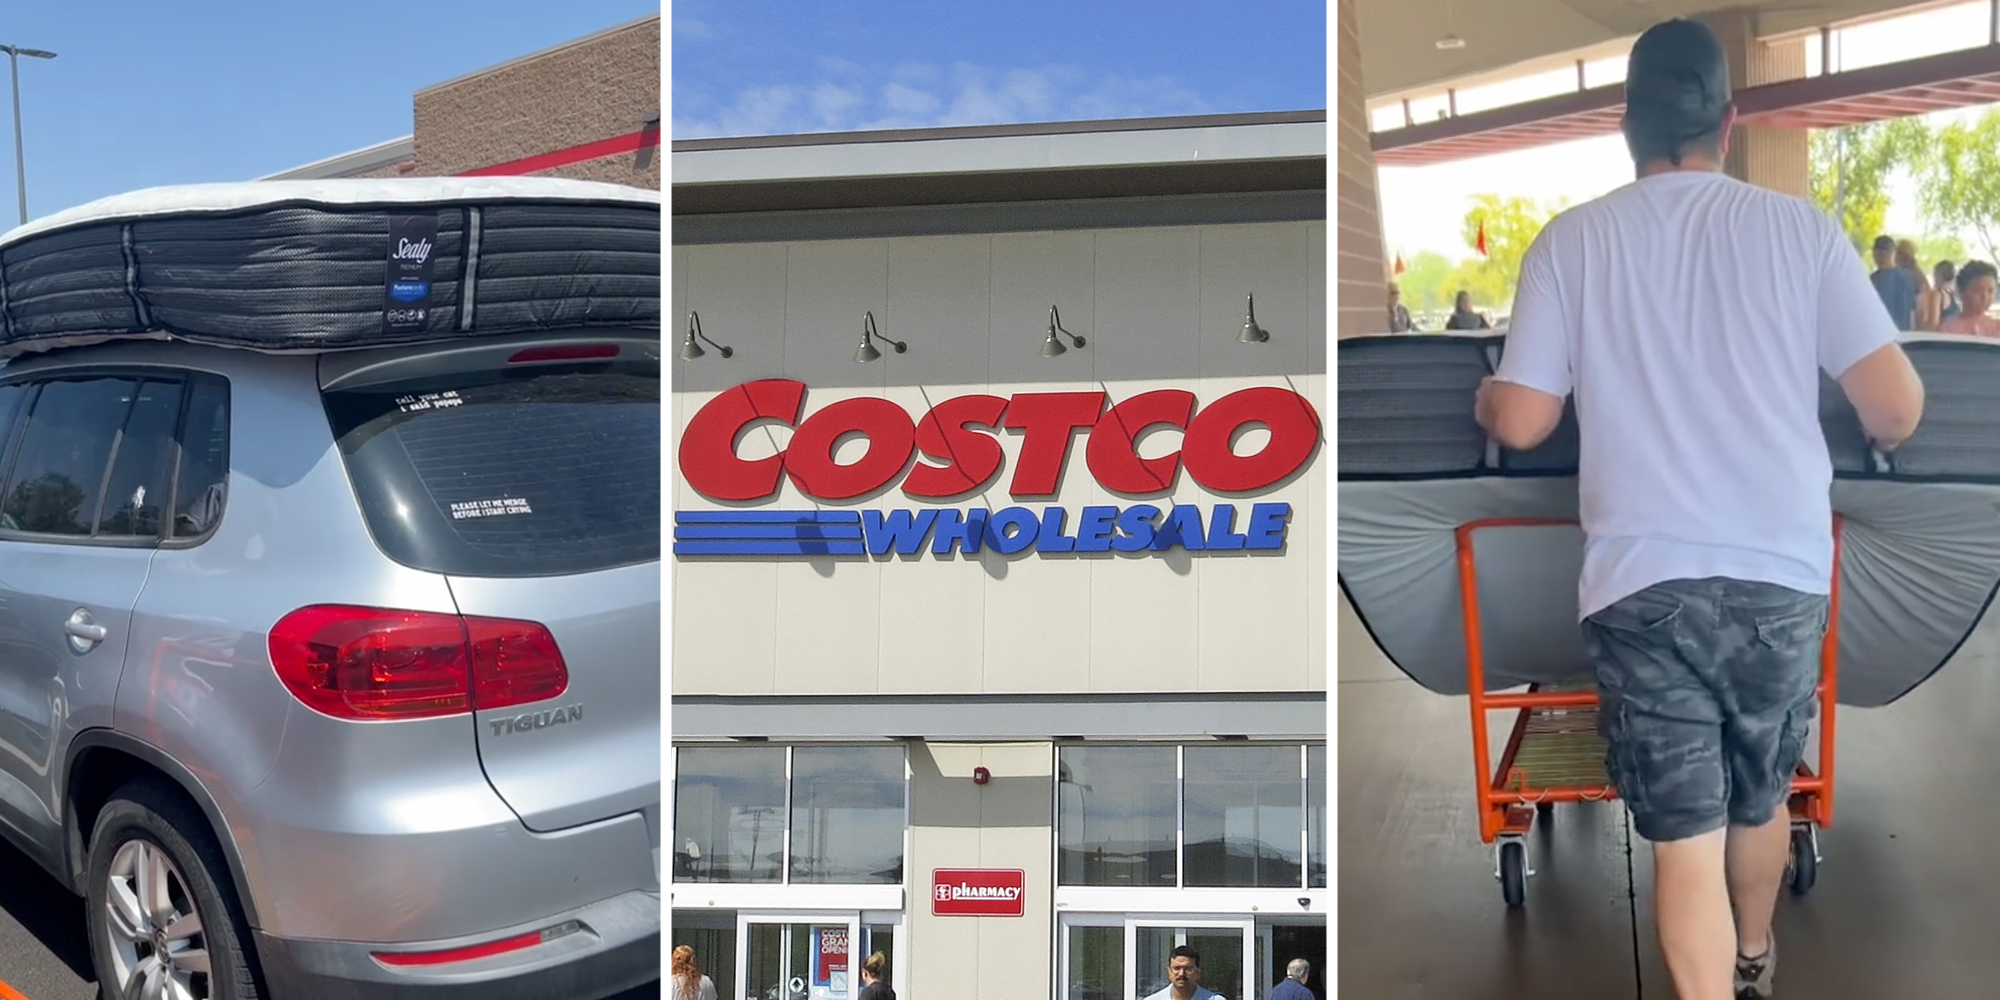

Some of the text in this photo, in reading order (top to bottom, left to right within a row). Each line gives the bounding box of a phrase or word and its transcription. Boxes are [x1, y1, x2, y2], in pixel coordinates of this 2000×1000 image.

[392, 237, 432, 264] Sealy
[395, 390, 459, 405] tell your cat
[410, 401, 431, 411] said
[679, 379, 1320, 500] COSTCO
[450, 498, 527, 511] PLEASE LET ME MERGE
[452, 510, 482, 520] BEFORE
[485, 507, 506, 516] START
[507, 505, 532, 515] CRYING
[862, 502, 1290, 557] WHOLESALE
[489, 703, 583, 737] TIGUAN
